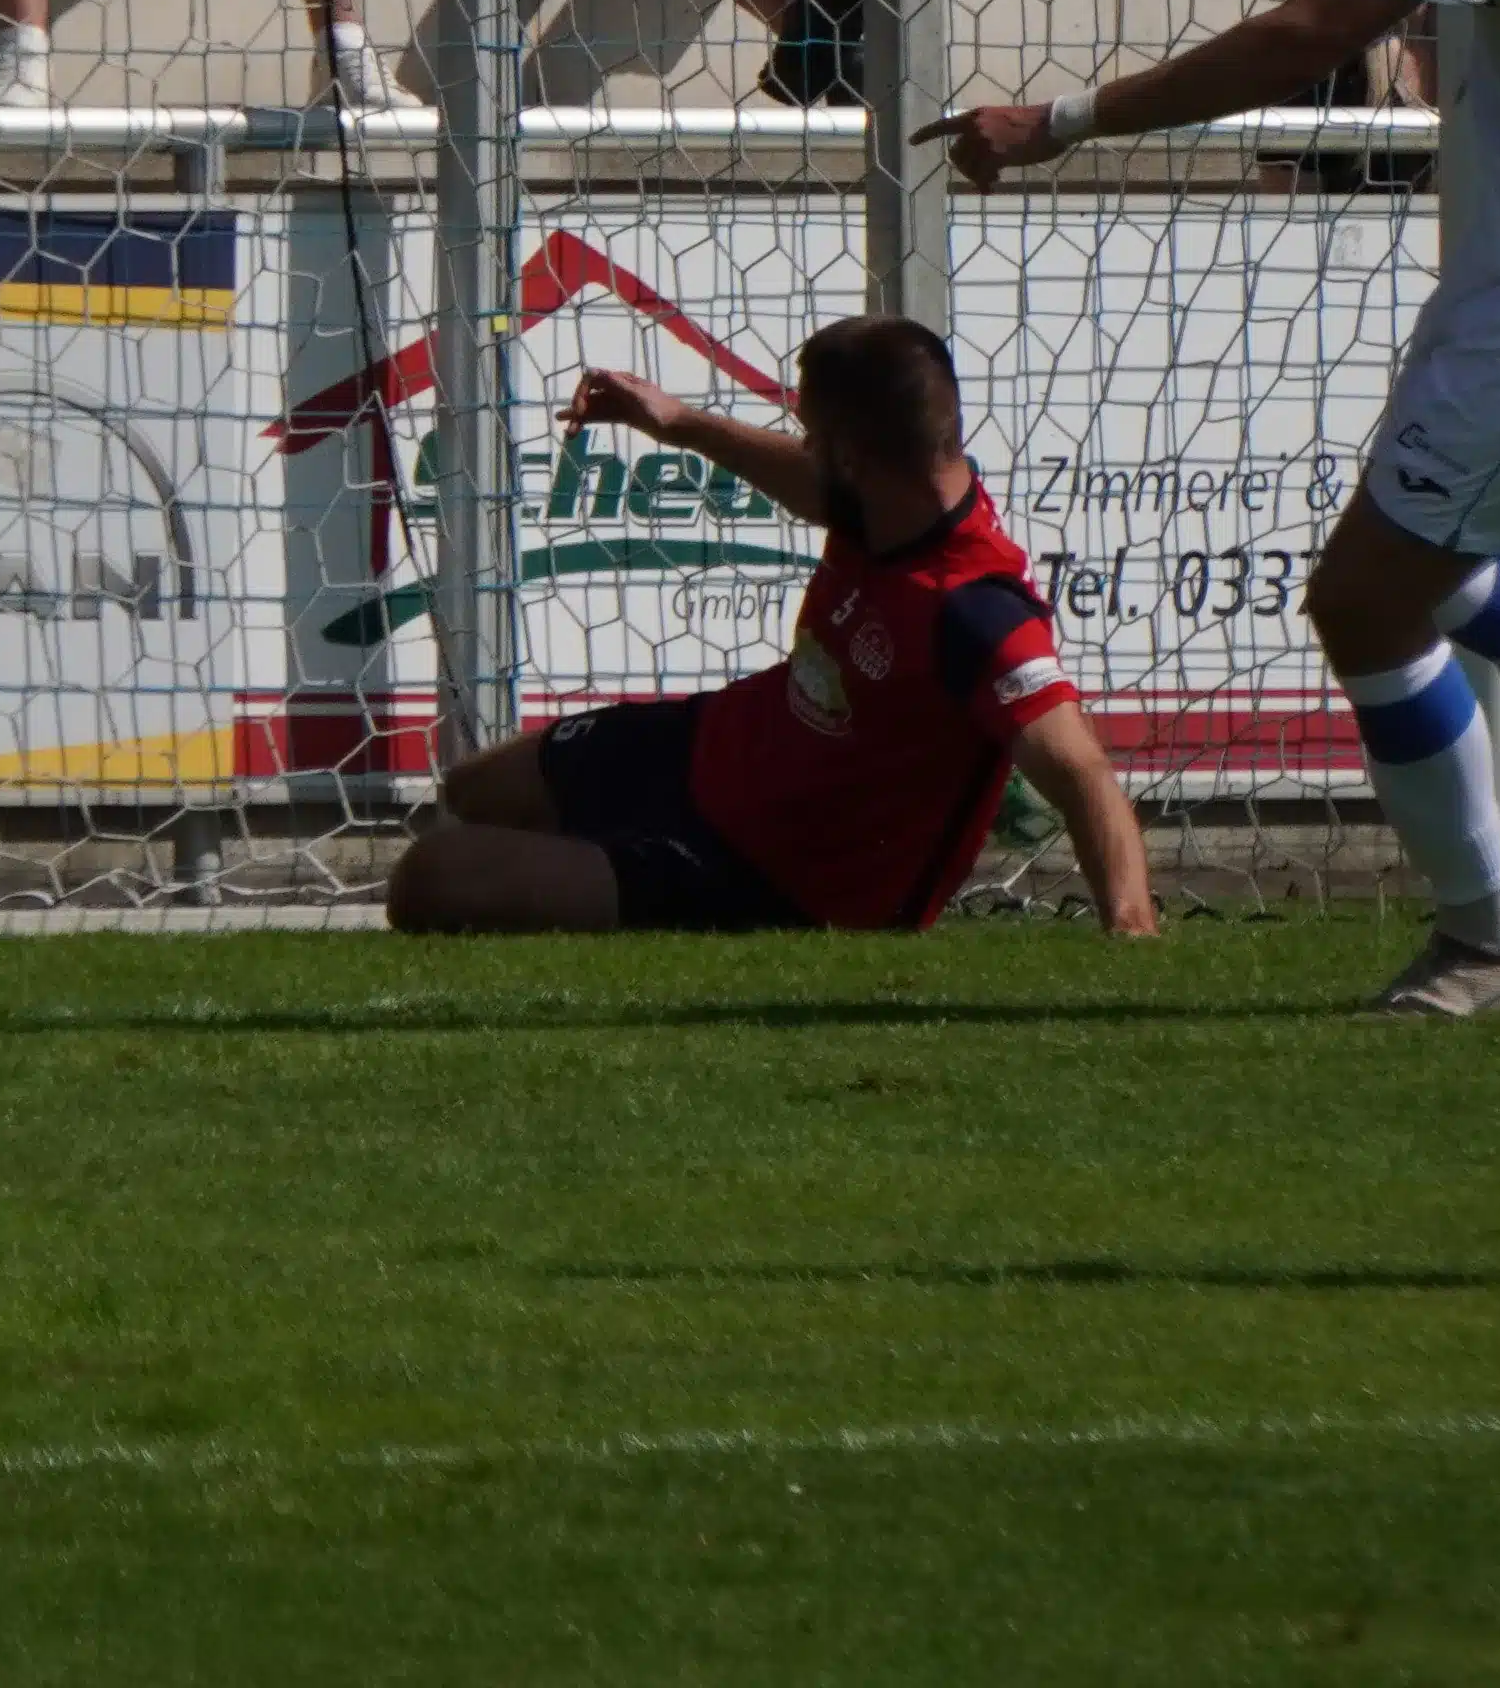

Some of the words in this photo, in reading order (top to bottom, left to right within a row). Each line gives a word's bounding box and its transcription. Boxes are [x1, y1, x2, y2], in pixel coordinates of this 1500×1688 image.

[1032, 455, 1286, 514] Zimmerei
[1305, 451, 1341, 511] &
[671, 584, 789, 621] GmbH
[1036, 551, 1138, 616] Tel.
